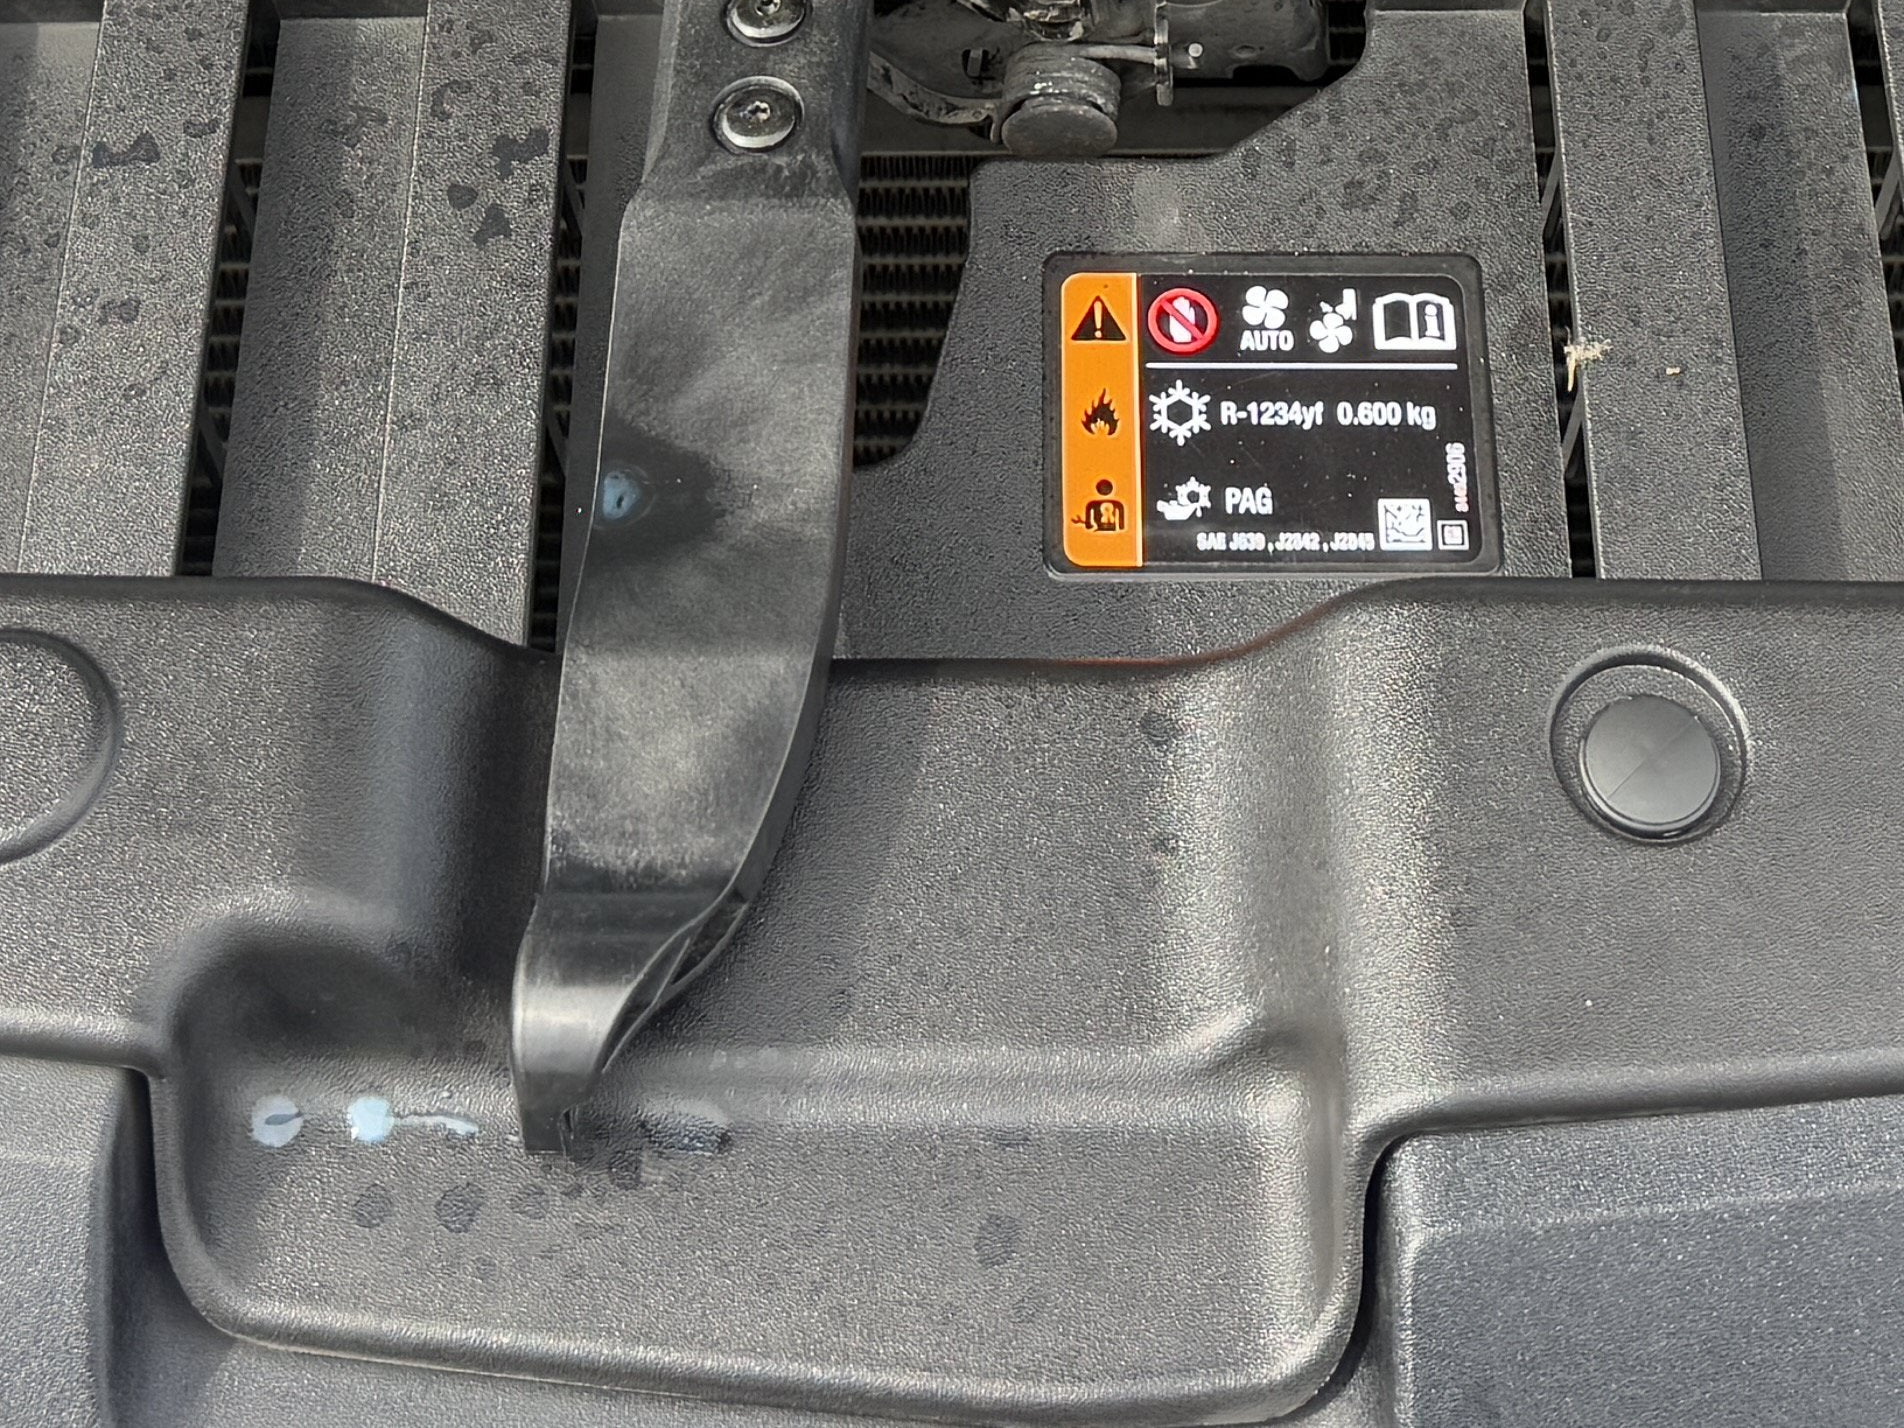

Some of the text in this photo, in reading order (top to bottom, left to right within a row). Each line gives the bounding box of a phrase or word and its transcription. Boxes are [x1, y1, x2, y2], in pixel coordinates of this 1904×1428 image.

[1239, 330, 1294, 351] AUTO
[1220, 402, 1436, 431] R-1234yf 0.600 kg
[1225, 487, 1273, 515] PAG
[1196, 532, 1226, 551] SAE
